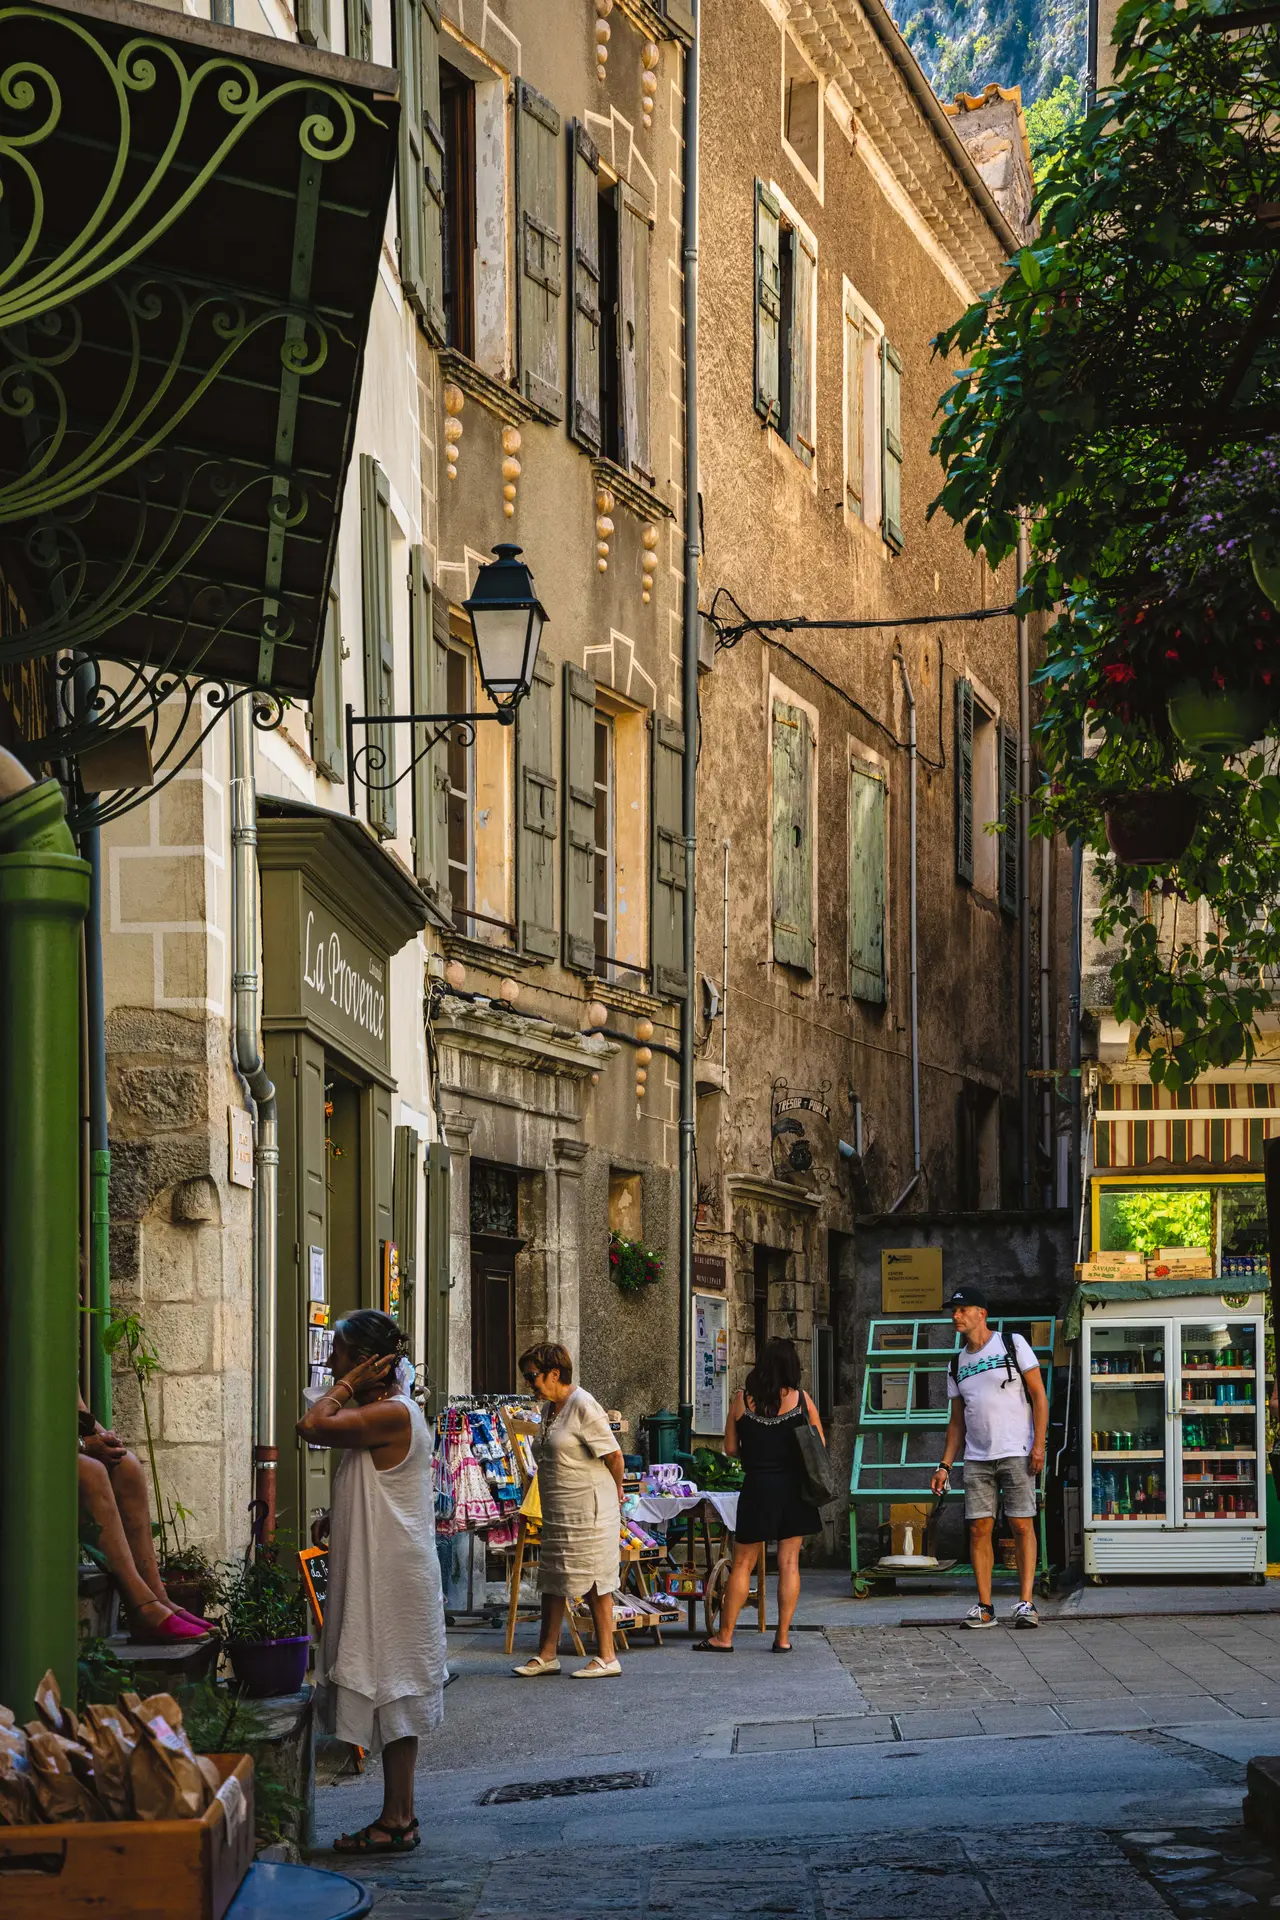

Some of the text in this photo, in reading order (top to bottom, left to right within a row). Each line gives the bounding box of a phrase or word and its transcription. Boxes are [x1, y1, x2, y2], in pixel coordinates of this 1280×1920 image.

[303, 910, 385, 1041] La Provence
[778, 1097, 829, 1118] TRESOR PUBLIC
